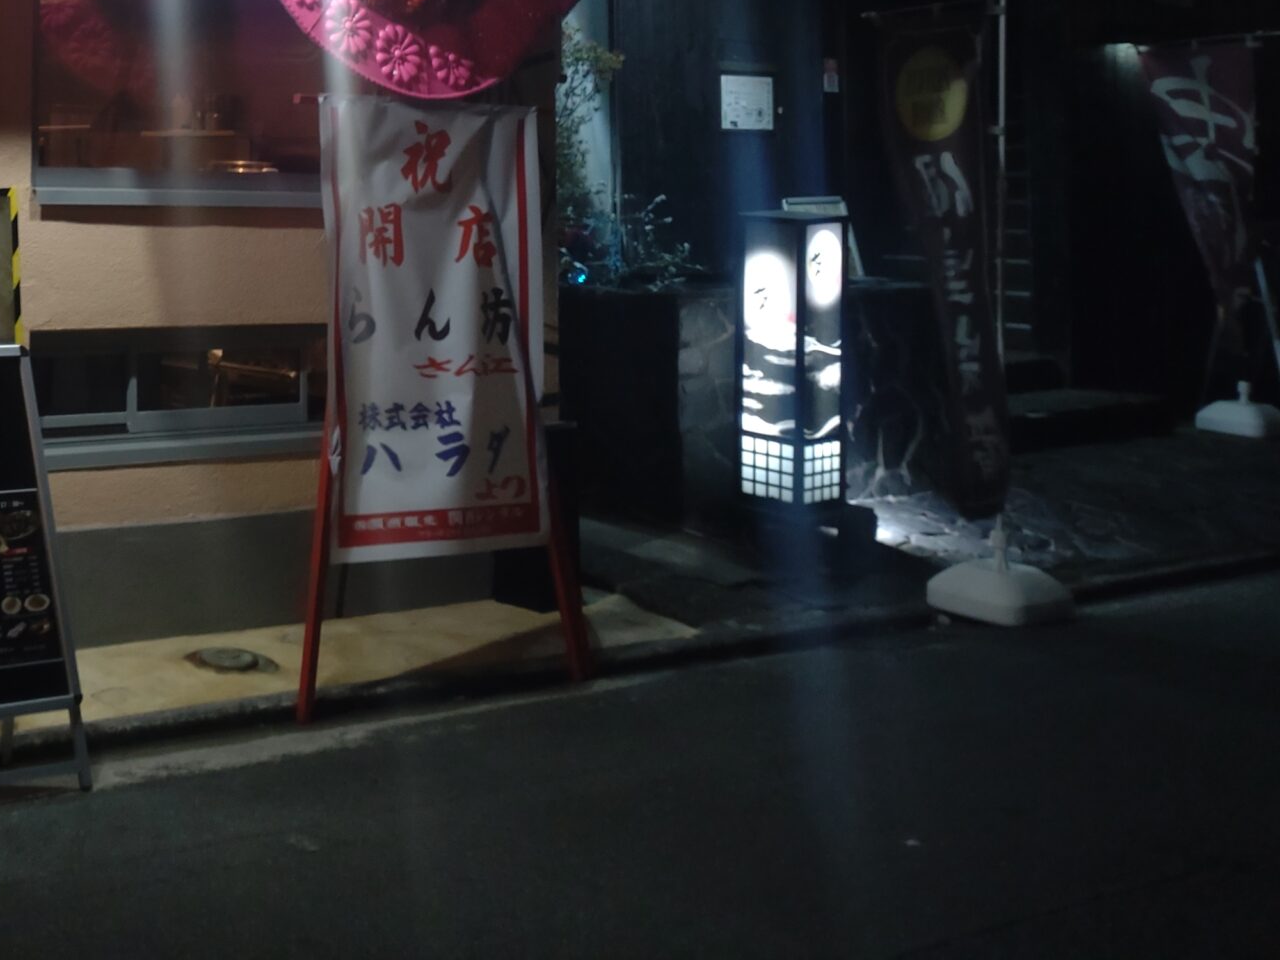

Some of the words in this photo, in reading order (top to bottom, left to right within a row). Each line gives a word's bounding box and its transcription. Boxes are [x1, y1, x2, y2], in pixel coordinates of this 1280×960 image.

[401, 119, 452, 194] 祝
[358, 202, 496, 268] 開店
[349, 287, 512, 345] らん坊
[359, 401, 461, 431] 株式会社
